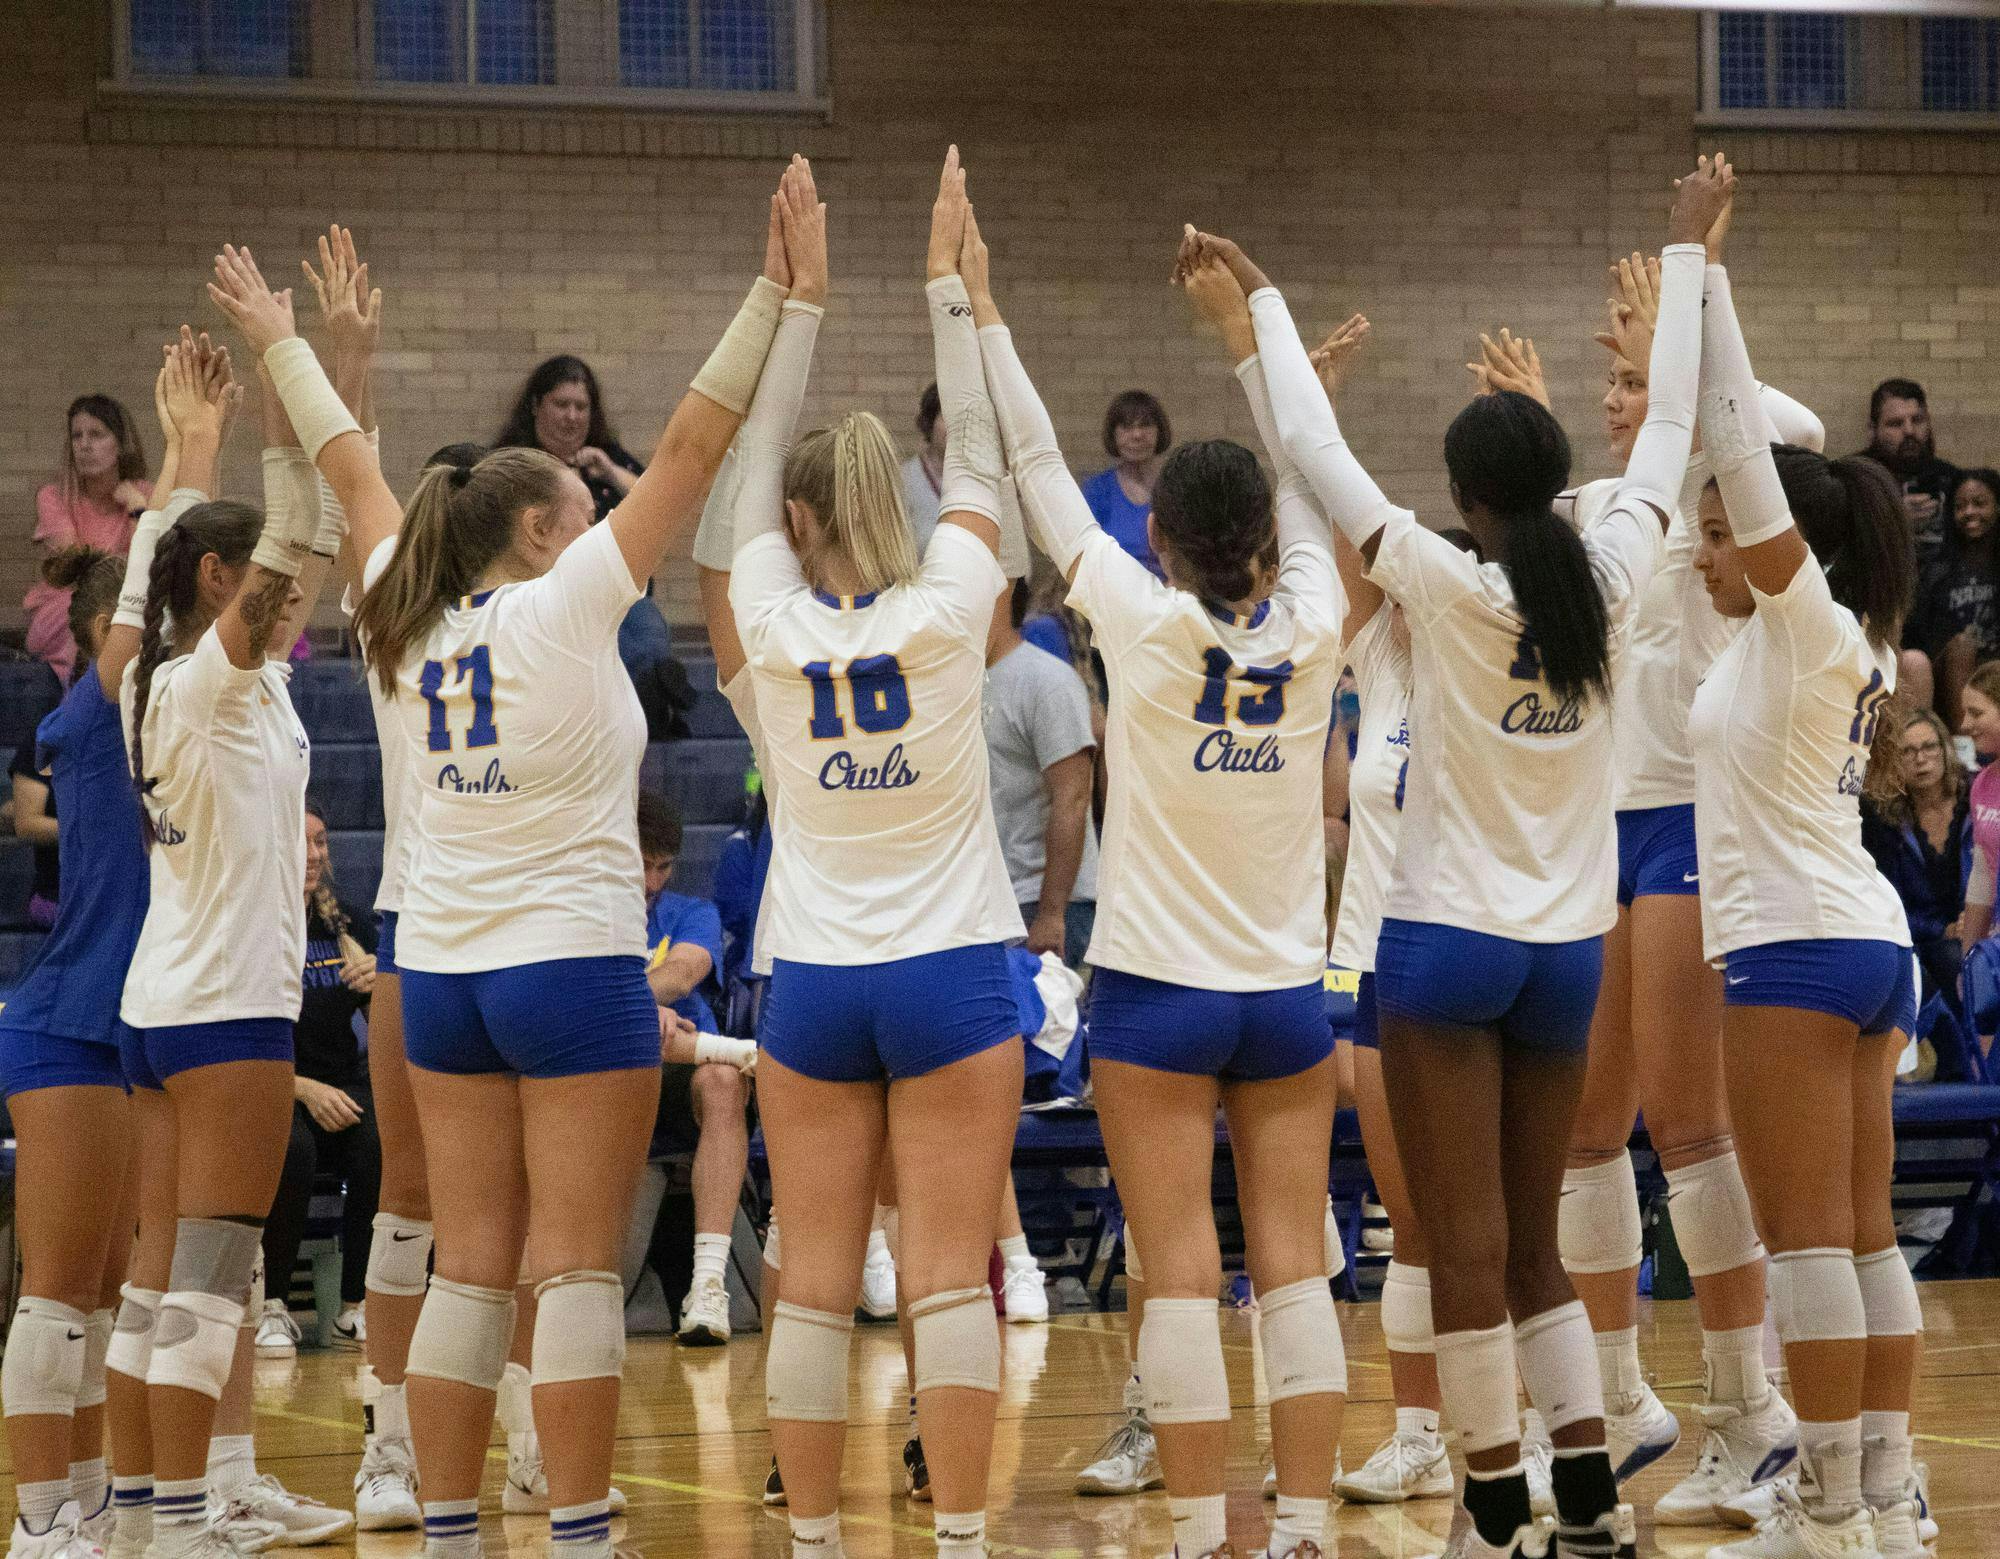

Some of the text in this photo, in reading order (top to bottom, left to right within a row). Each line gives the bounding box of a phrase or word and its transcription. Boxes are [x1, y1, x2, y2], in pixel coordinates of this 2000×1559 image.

[418, 643, 499, 755] 17
[1501, 692, 1583, 734] Owls
[818, 742, 920, 790] Owls
[1193, 729, 1286, 773] Owls
